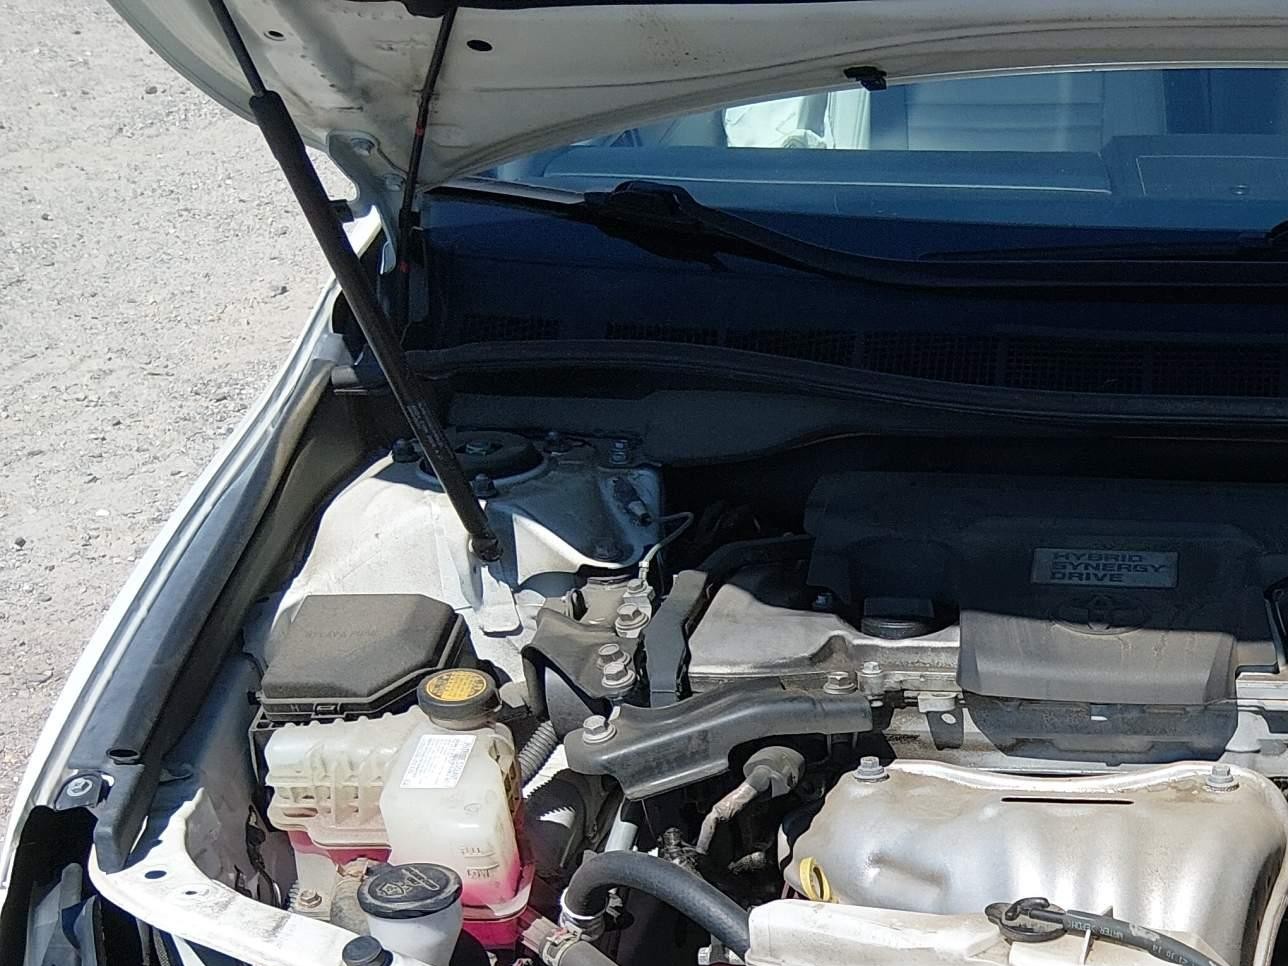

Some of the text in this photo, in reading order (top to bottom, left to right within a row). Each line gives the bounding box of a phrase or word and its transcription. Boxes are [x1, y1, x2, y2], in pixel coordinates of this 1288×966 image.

[1053, 552, 1143, 562] HYBRID
[1053, 561, 1167, 573] SYNERGY
[1051, 571, 1124, 583] DRIVE
